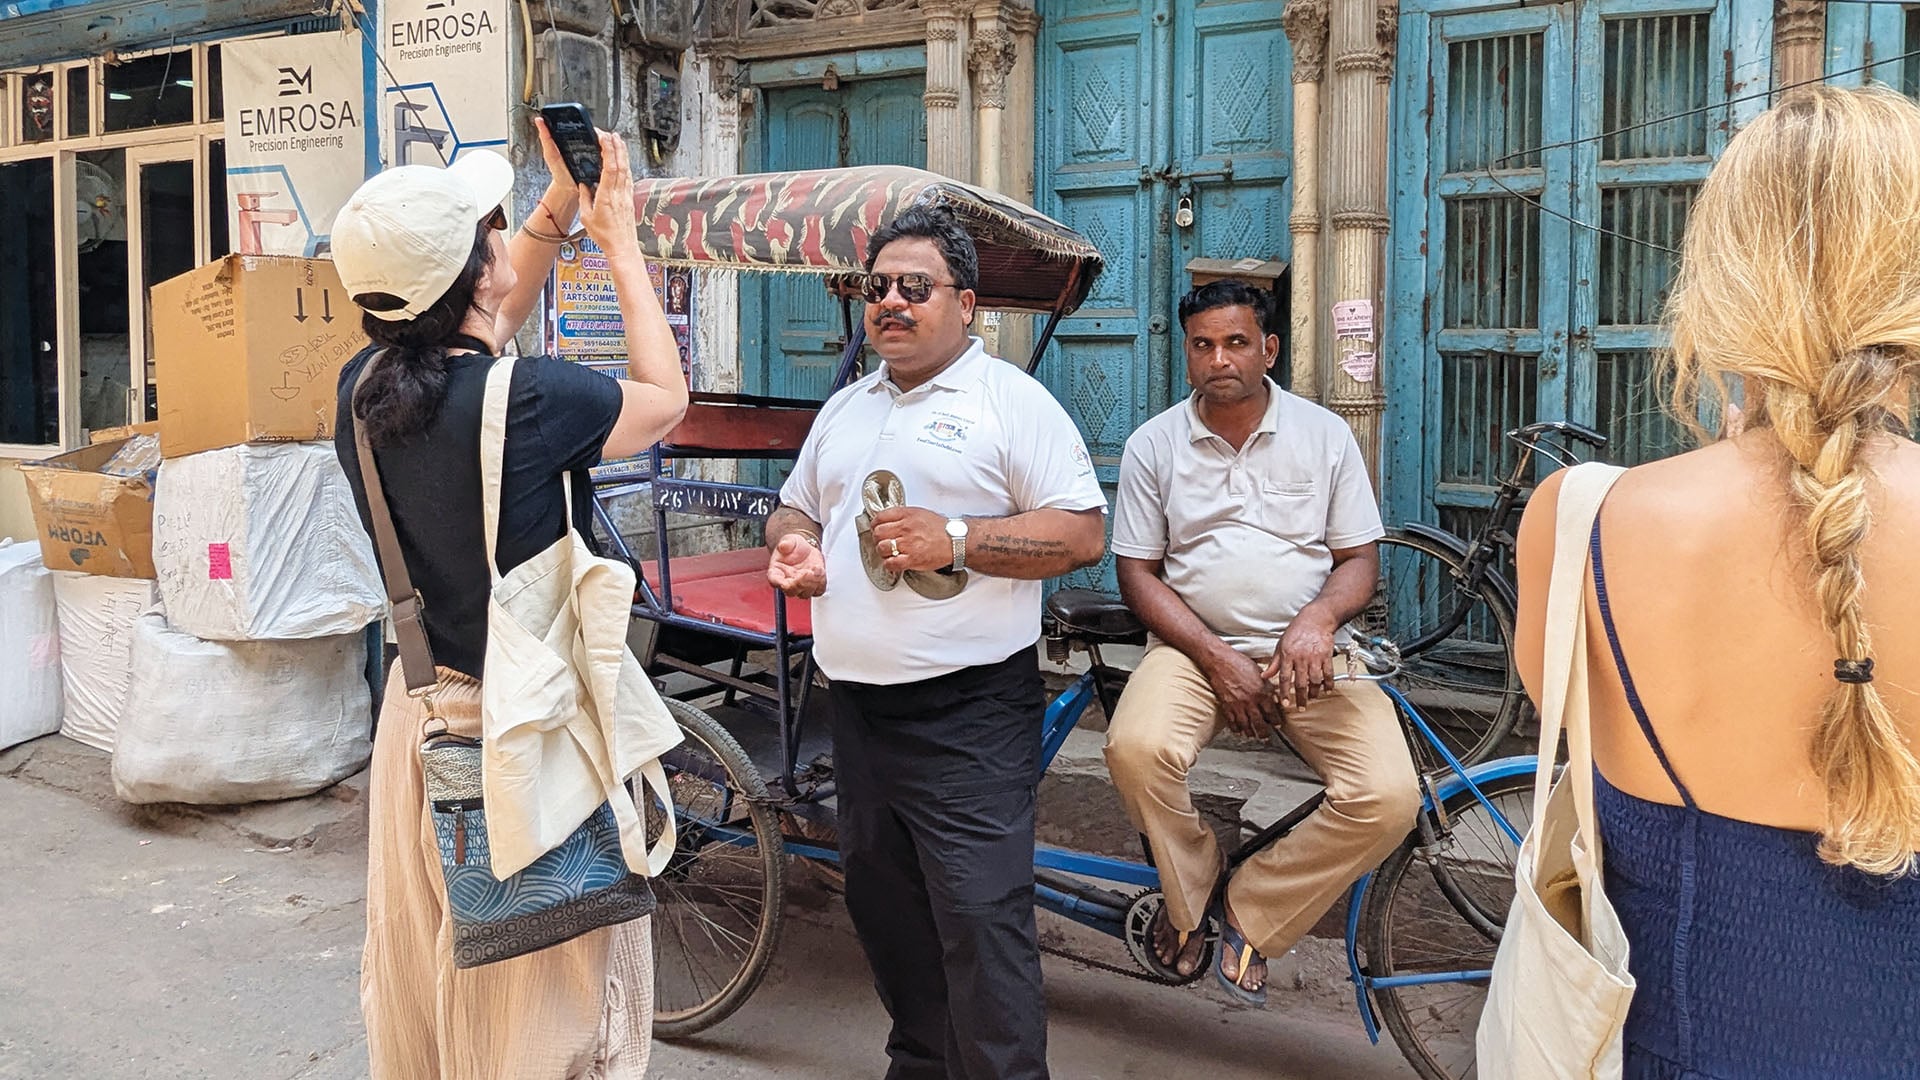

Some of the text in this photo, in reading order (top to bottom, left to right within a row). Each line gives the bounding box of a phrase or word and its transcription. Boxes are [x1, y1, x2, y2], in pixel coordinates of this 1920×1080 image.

[392, 10, 493, 47] EMROSA
[400, 40, 482, 60] Precision Engineering
[240, 101, 356, 137] EMROSA
[249, 134, 343, 152] Precision Engineering
[602, 284, 617, 292] AL
[660, 488, 769, 516] 26 VIJAY 26
